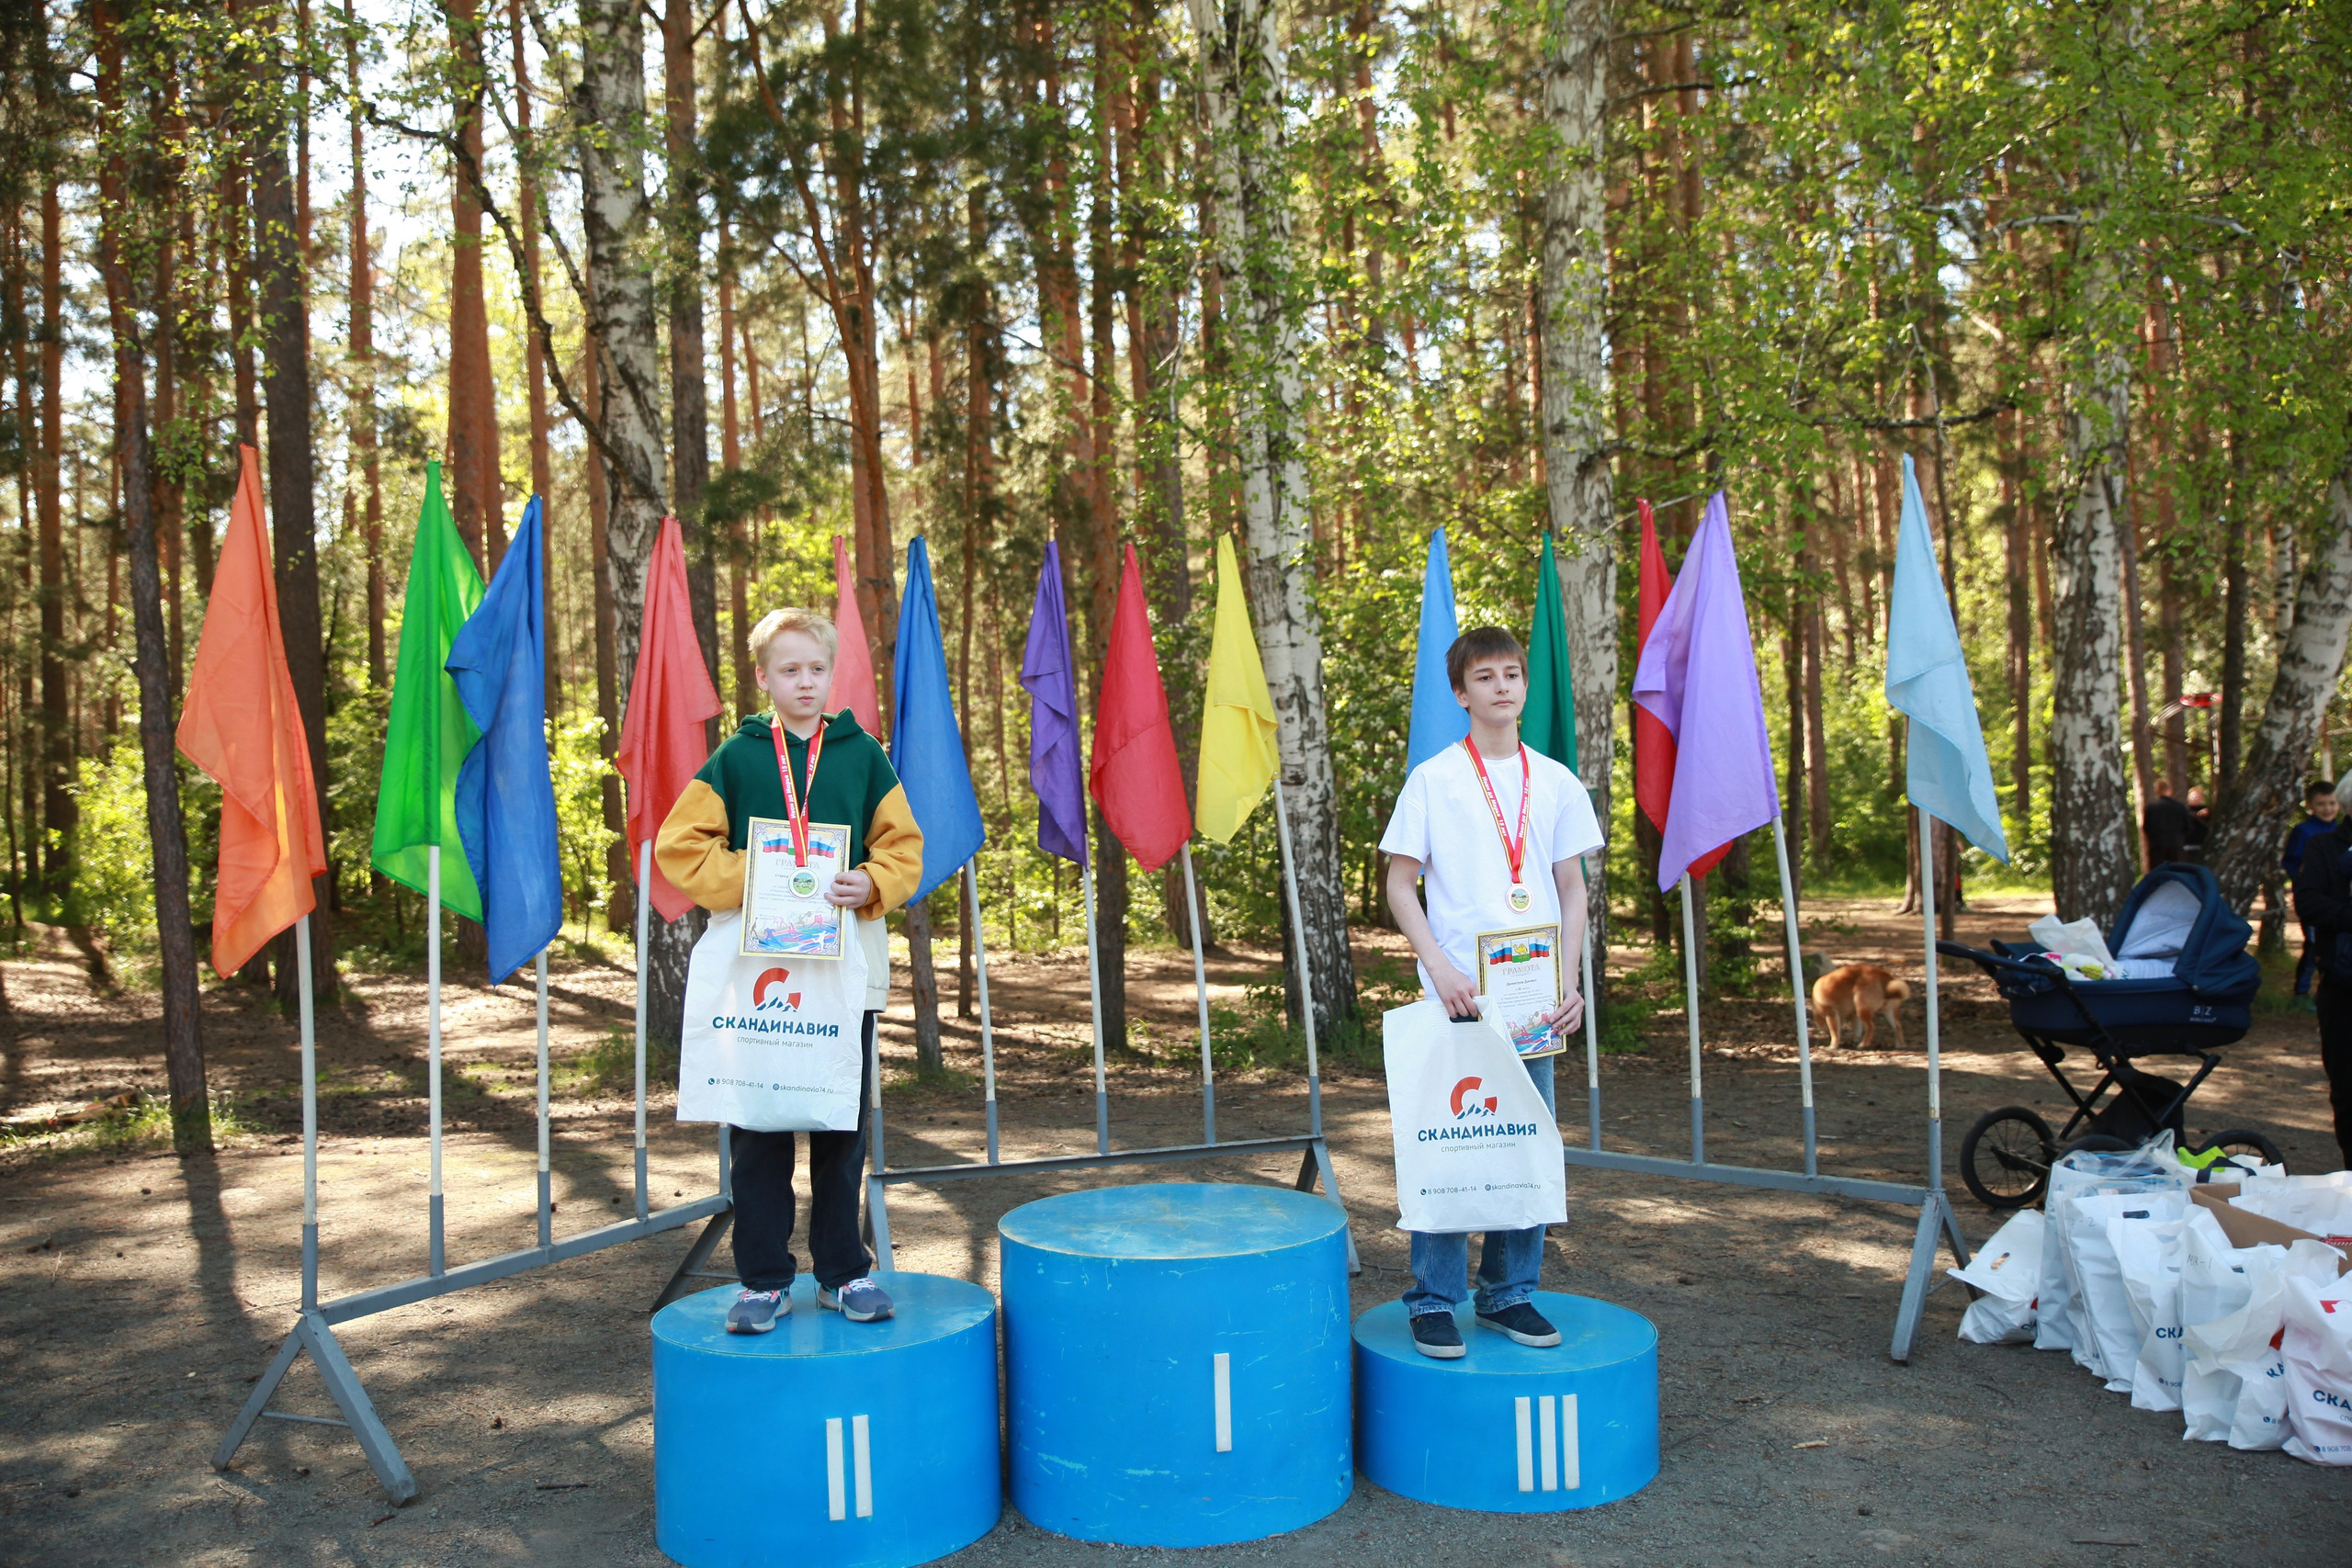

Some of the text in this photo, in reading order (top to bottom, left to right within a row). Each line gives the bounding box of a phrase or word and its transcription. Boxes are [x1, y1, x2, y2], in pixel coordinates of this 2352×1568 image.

[775, 858, 820, 869] ГРАТА
[1502, 964, 1541, 976] ГРАМОТА
[712, 1016, 840, 1038] СКАНДИНАВИЯ
[737, 1035, 813, 1049] спортивный магазин
[735, 1079, 763, 1089] 708-41-14
[1418, 1122, 1537, 1142] СКАНДИНАВИЯ
[1441, 1141, 1516, 1153] спортивный магазин
[1432, 1187, 1445, 1195] 908
[1515, 1393, 1580, 1492] III
[826, 1415, 873, 1521] II
